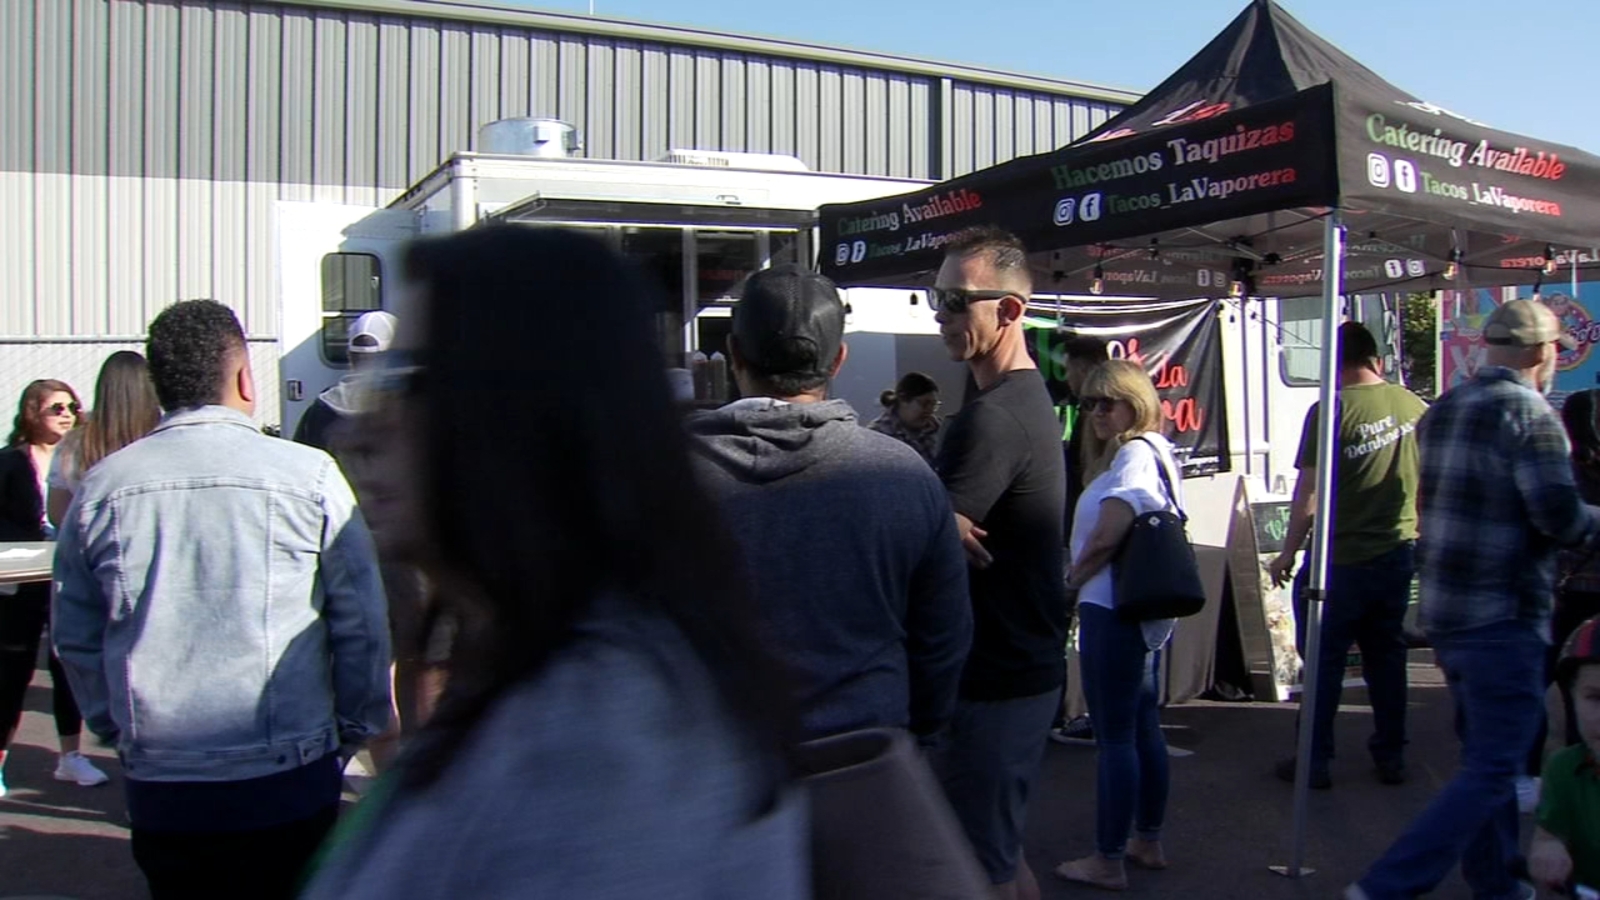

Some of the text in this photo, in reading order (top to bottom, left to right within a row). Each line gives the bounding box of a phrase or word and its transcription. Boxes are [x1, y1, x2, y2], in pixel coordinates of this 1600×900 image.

[1051, 151, 1163, 190] Hacemos
[1167, 120, 1295, 165] Taquizas
[1366, 113, 1467, 166] Catering
[1469, 140, 1566, 180] Available
[838, 188, 982, 235] Catering Available
[1108, 168, 1297, 214] Tacos_LaVaporera
[1420, 172, 1561, 216] Tacos_LaVaporera
[1359, 415, 1396, 440] Pure
